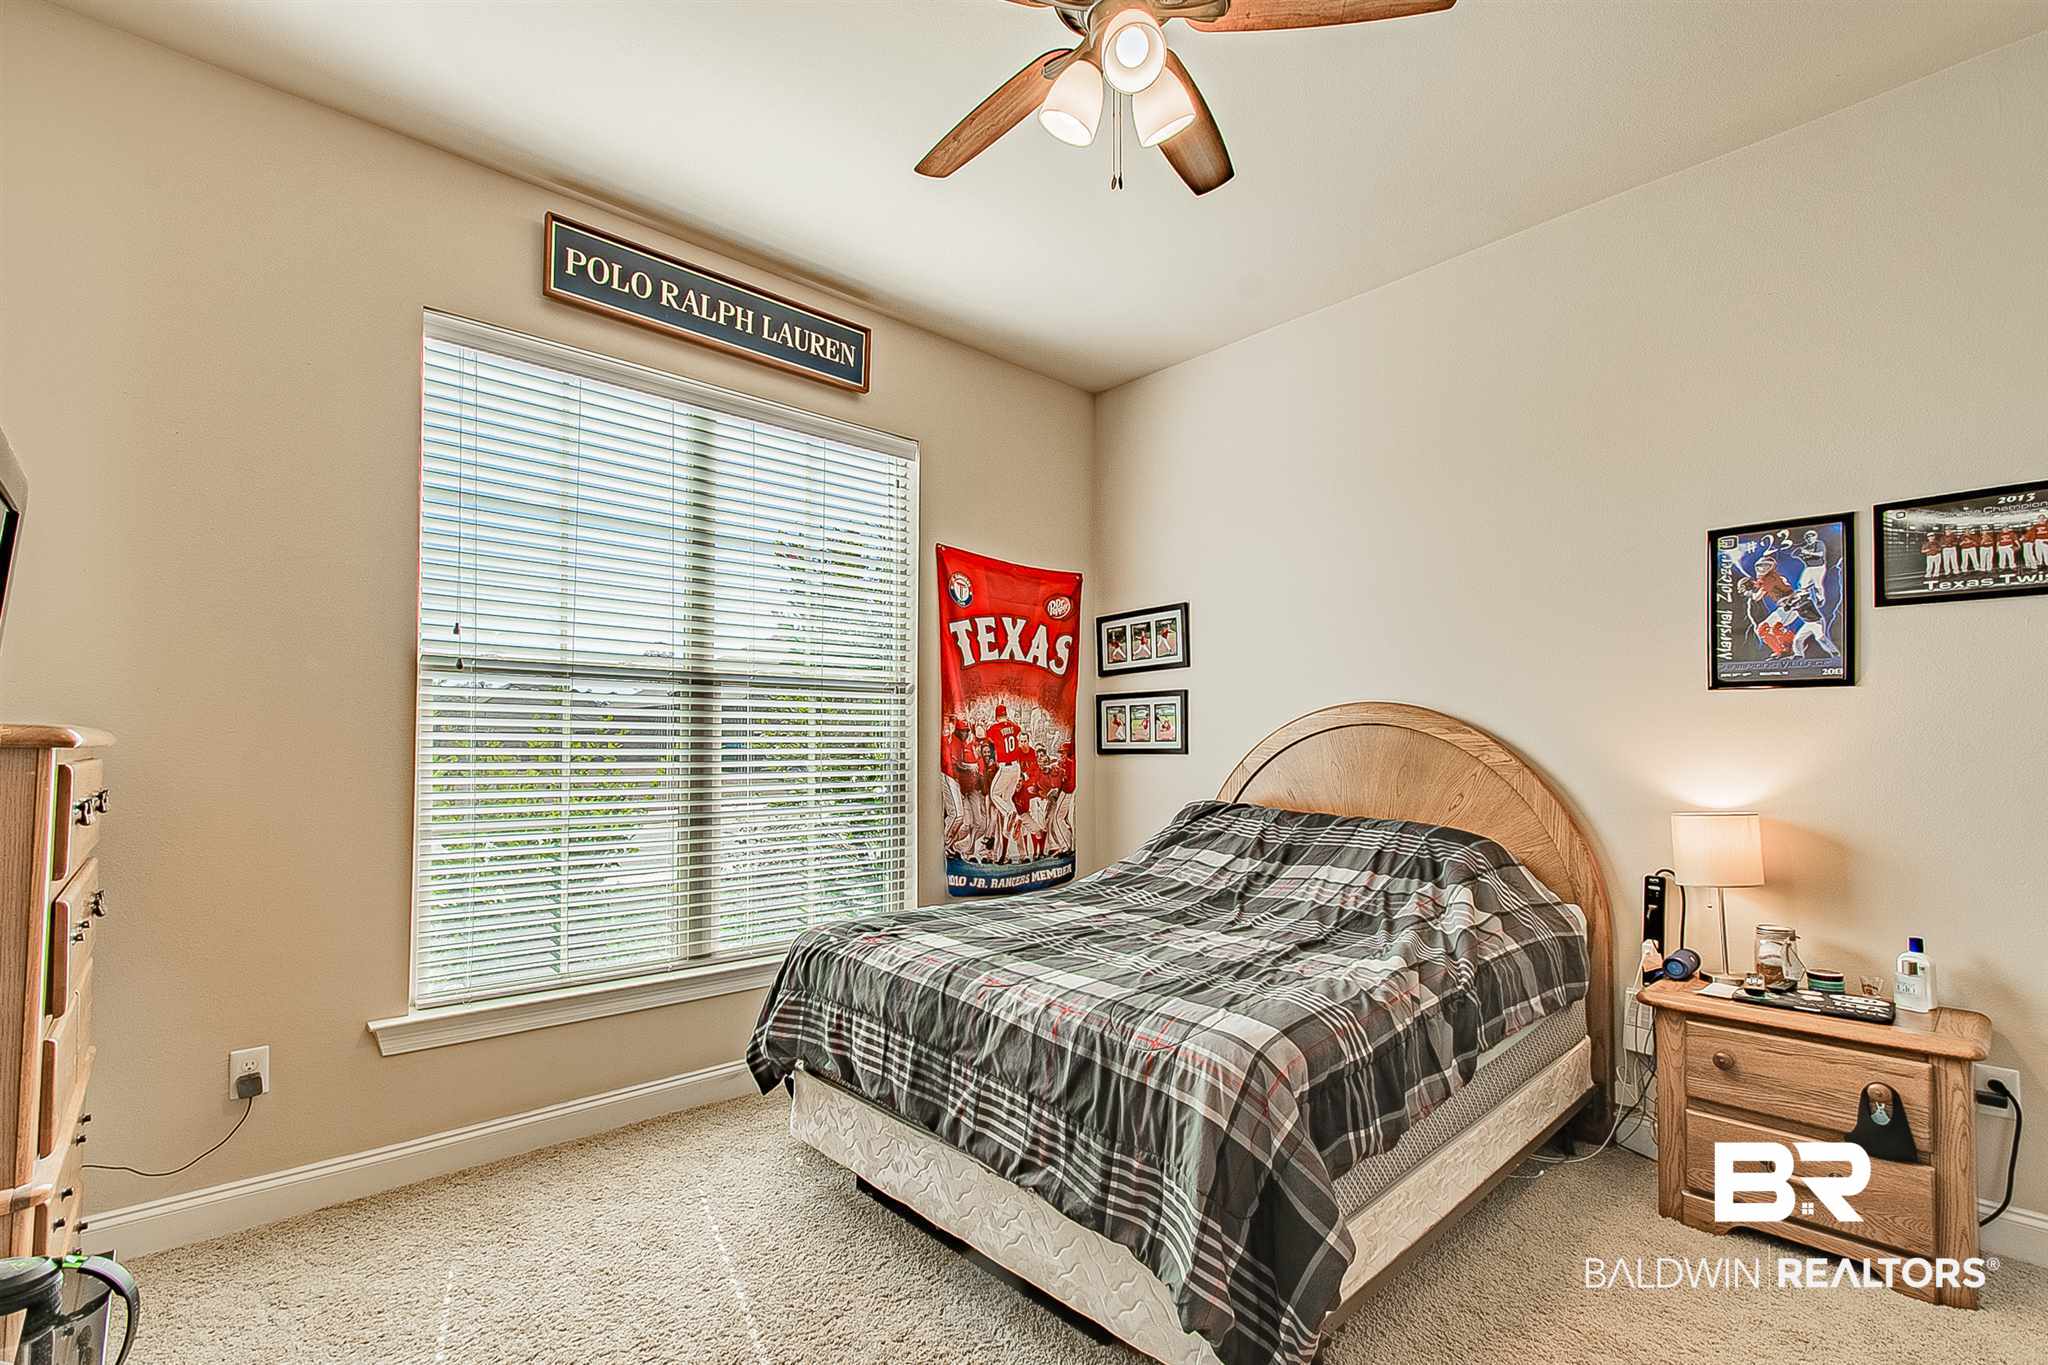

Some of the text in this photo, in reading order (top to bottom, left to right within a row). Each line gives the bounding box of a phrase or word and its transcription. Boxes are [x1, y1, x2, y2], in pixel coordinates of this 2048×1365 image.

[565, 247, 856, 368] POLO RALPH LAUREN
[1922, 571, 2048, 592] Texas Twi
[949, 616, 1073, 676] TEXAS
[1716, 609, 1733, 660] Marshal
[1004, 735, 1015, 753] 10
[969, 877, 988, 889] JR.
[990, 875, 1030, 889] RANGERS
[1031, 864, 1072, 882] MEMBER
